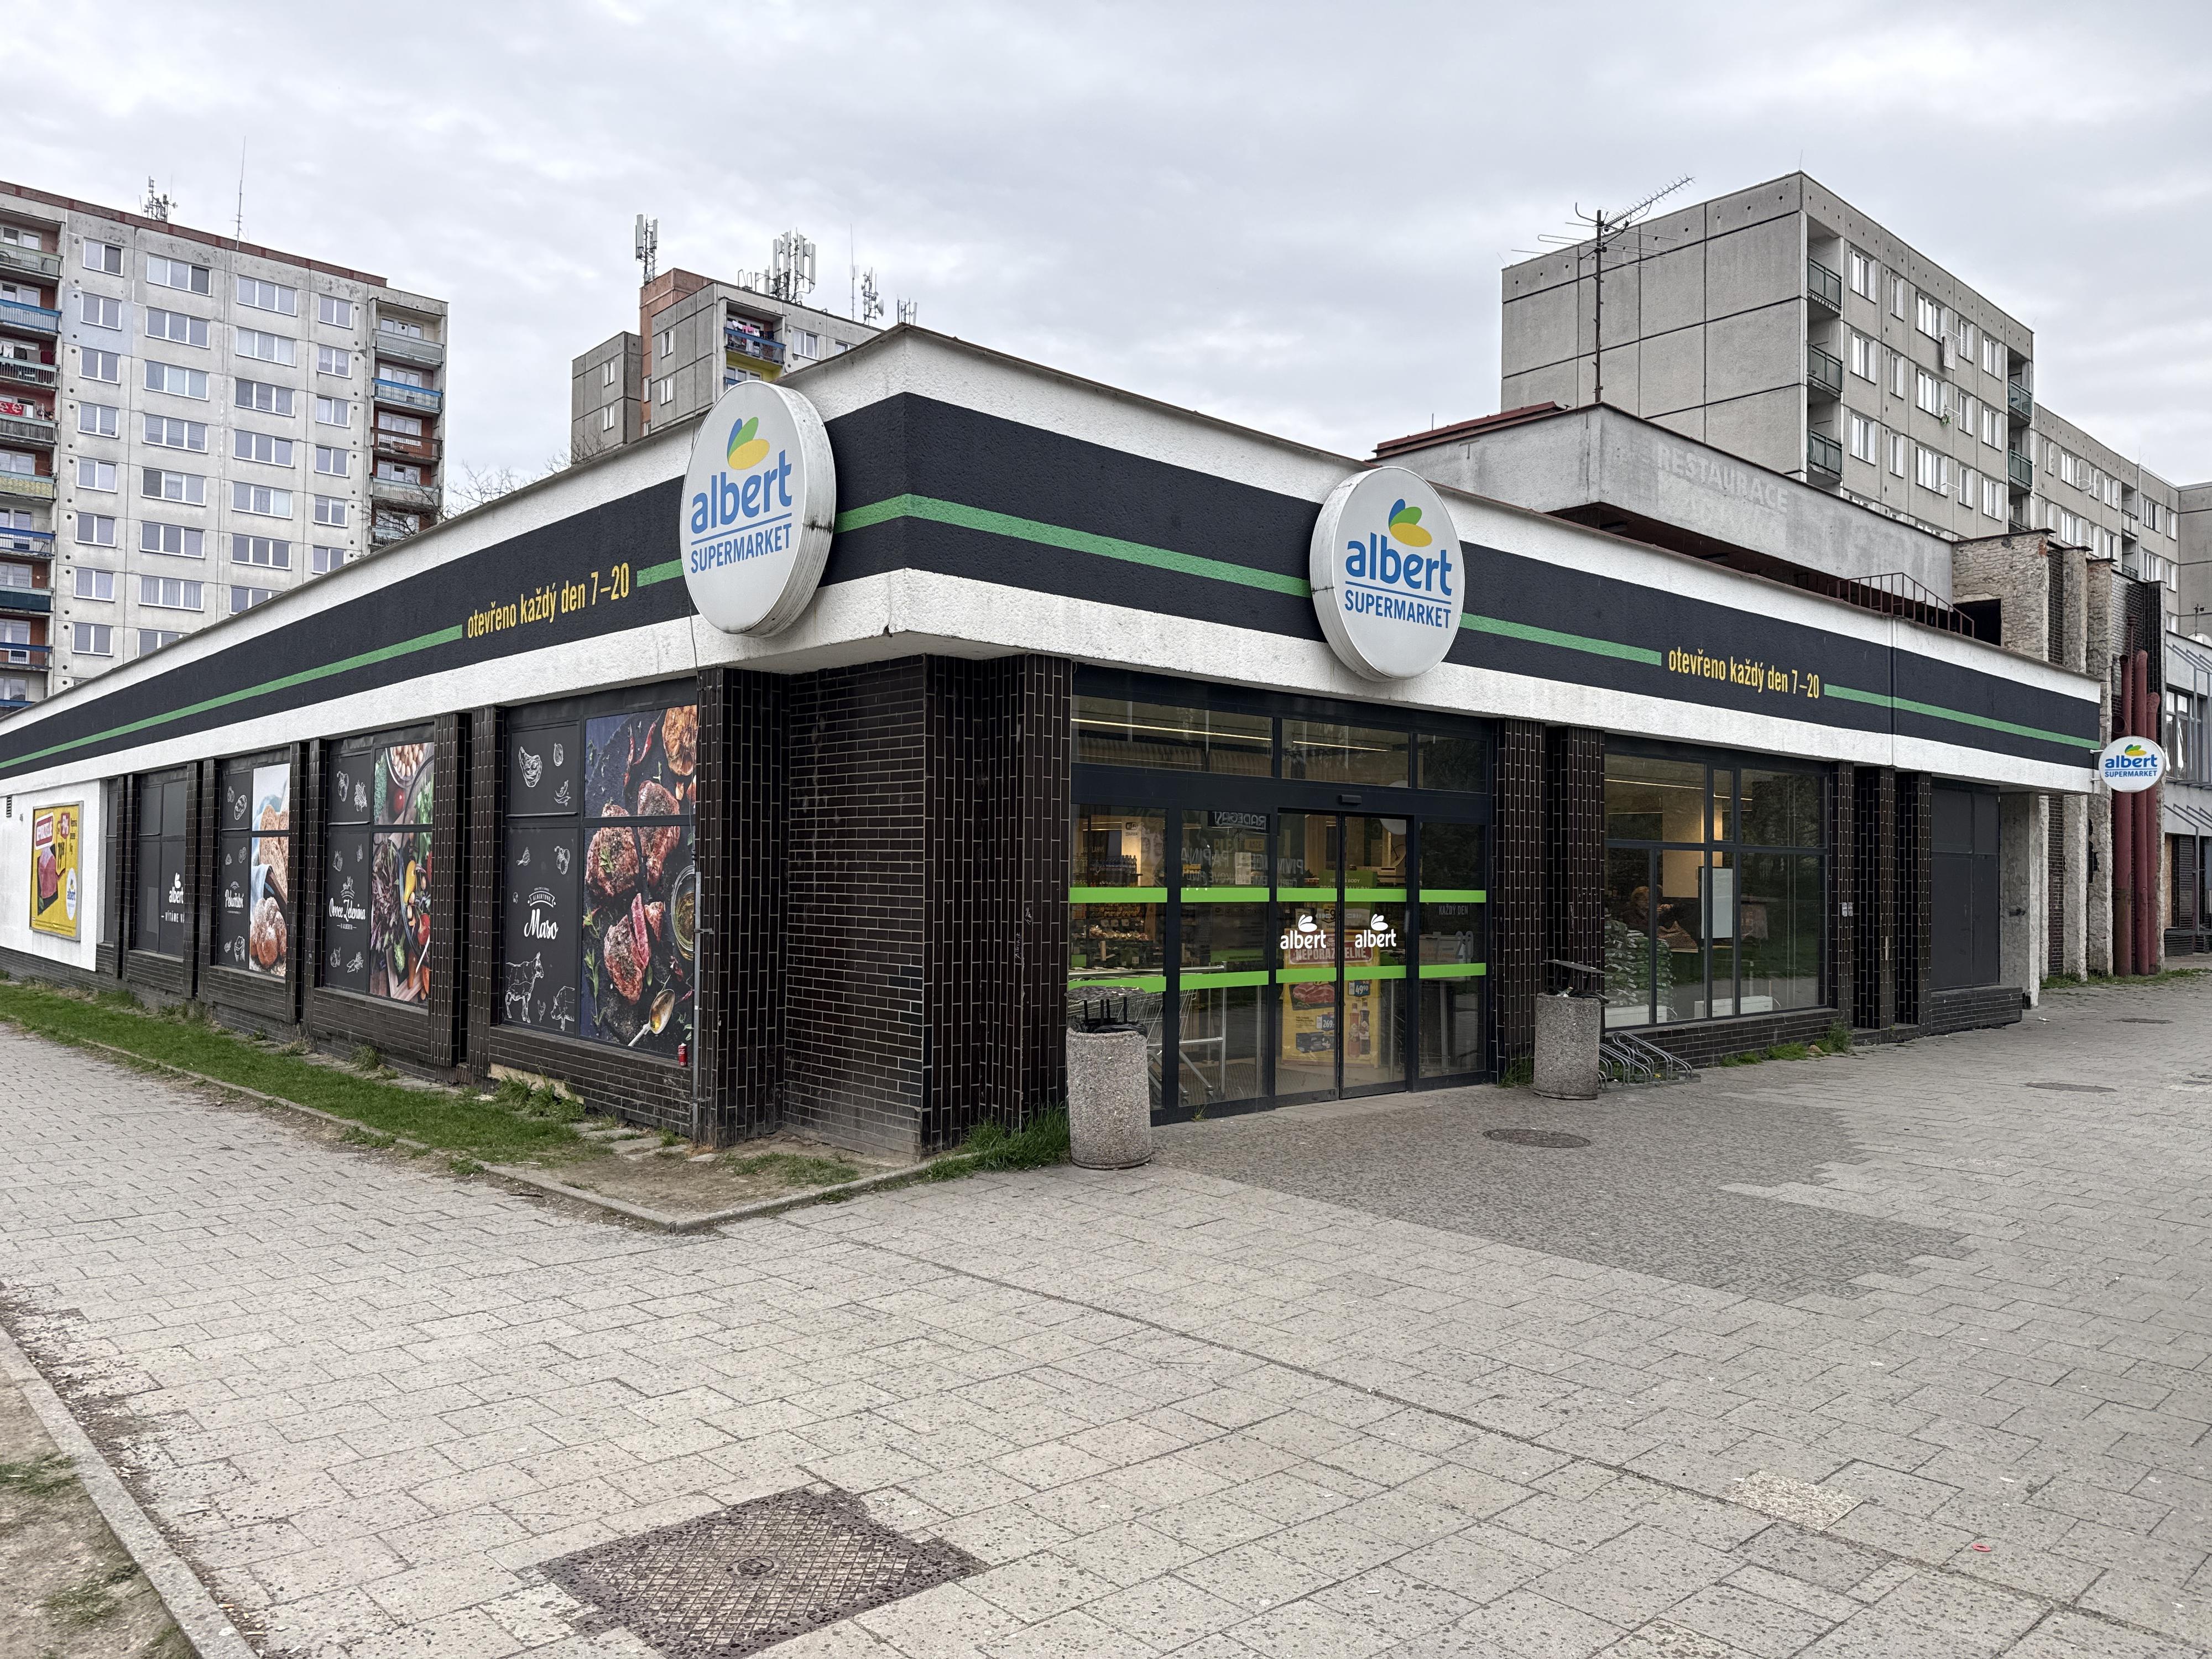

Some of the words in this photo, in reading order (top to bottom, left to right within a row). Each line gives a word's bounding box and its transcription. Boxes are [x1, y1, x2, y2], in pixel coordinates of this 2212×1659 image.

[691, 449, 792, 534] albert
[1659, 442, 1788, 513] RESTAURACE
[691, 523, 792, 574] SUPERMARKET
[1345, 532, 1452, 596] albert
[468, 601, 517, 639] otevřeno
[520, 582, 557, 623] každý
[561, 580, 585, 614] den
[1344, 589, 1451, 629] SUPERMARKET
[1668, 646, 1726, 681] otevřeno
[1730, 656, 1764, 693] každý
[1767, 665, 1788, 692] den
[2105, 754, 2158, 768] albert
[169, 886, 184, 904] albert
[343, 899, 366, 922] Zelenina
[1439, 903, 1457, 915] KAŽDÝ
[1457, 905, 1468, 915] DEN
[165, 910, 179, 922] VÍTÁME
[524, 908, 559, 940] Maso
[1280, 929, 1327, 950] albert
[1355, 928, 1397, 948] albert
